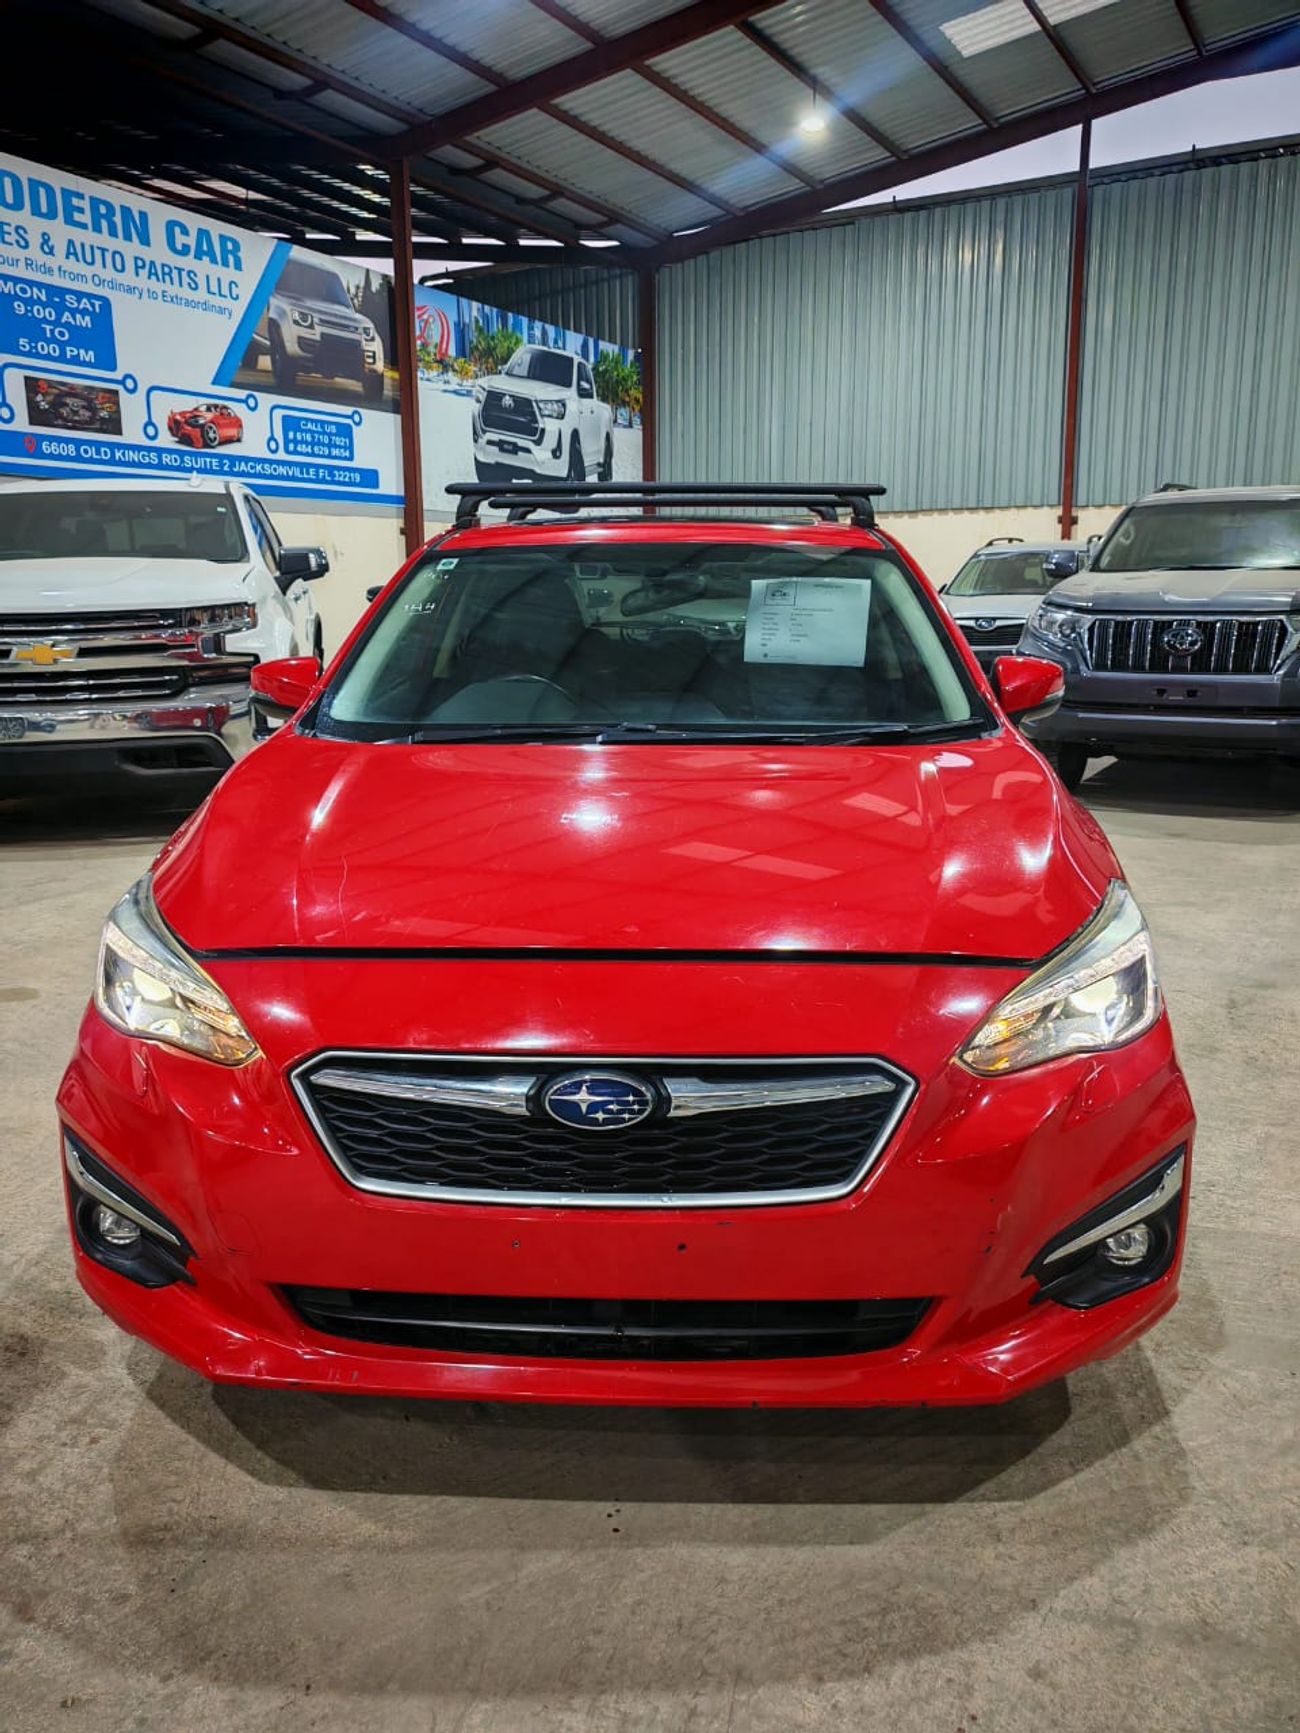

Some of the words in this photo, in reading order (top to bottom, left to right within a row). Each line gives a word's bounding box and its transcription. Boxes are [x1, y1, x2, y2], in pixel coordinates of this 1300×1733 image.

[0, 221, 30, 250] ES
[40, 232, 55, 257] &
[65, 239, 126, 274] AUTO
[133, 256, 199, 291] PARTS
[206, 274, 240, 301] LLC
[165, 219, 243, 272] CAR
[0, 280, 47, 302] MON
[64, 294, 103, 314] SAT
[24, 257, 54, 277] Ride
[58, 265, 88, 284] from
[92, 274, 144, 301] Ordinary
[147, 287, 158, 300] to
[161, 290, 233, 320] Extraordinary
[13, 301, 56, 321] 9:00
[61, 311, 92, 328] AM
[41, 323, 69, 341] TO
[18, 337, 59, 357] 5:00
[66, 346, 95, 363] PM
[300, 420, 323, 432] CALL
[42, 441, 76, 457] 6608
[80, 445, 111, 460] OLD
[115, 449, 159, 465] KINGS
[222, 459, 230, 471] 2
[233, 461, 317, 479] JACKSONVILLE
[319, 469, 331, 480] FL
[333, 470, 361, 483] 32219
